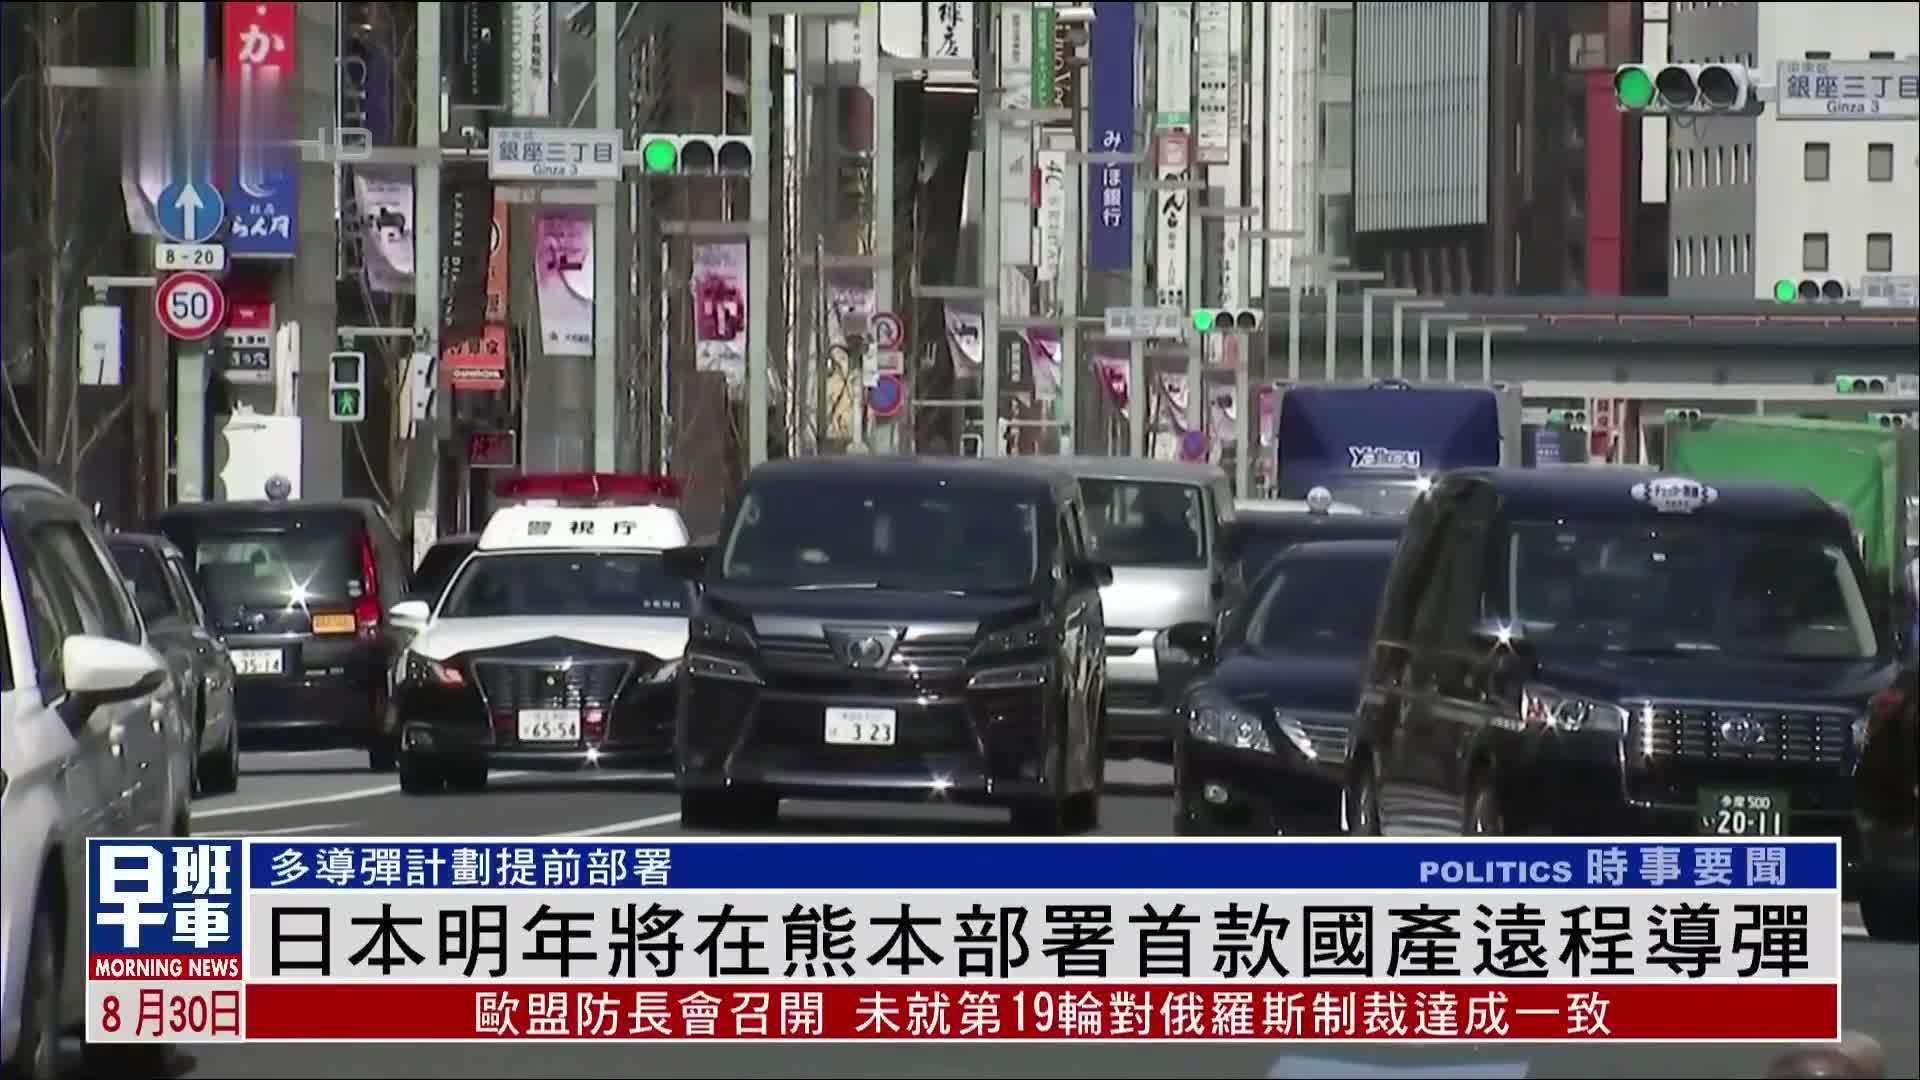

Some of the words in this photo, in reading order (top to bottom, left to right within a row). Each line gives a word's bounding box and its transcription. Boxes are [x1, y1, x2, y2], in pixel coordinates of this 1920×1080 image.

[1787, 74, 1919, 99] 銀座三丁目
[1826, 100, 1864, 113] Ginza
[1870, 100, 1880, 113] 3
[498, 142, 613, 162] 銀座三丁目
[532, 164, 565, 176] Ginza
[569, 164, 578, 176] 3
[172, 292, 209, 320] 50
[527, 520, 636, 536] 警視庁
[1717, 810, 1780, 835] 20-11
